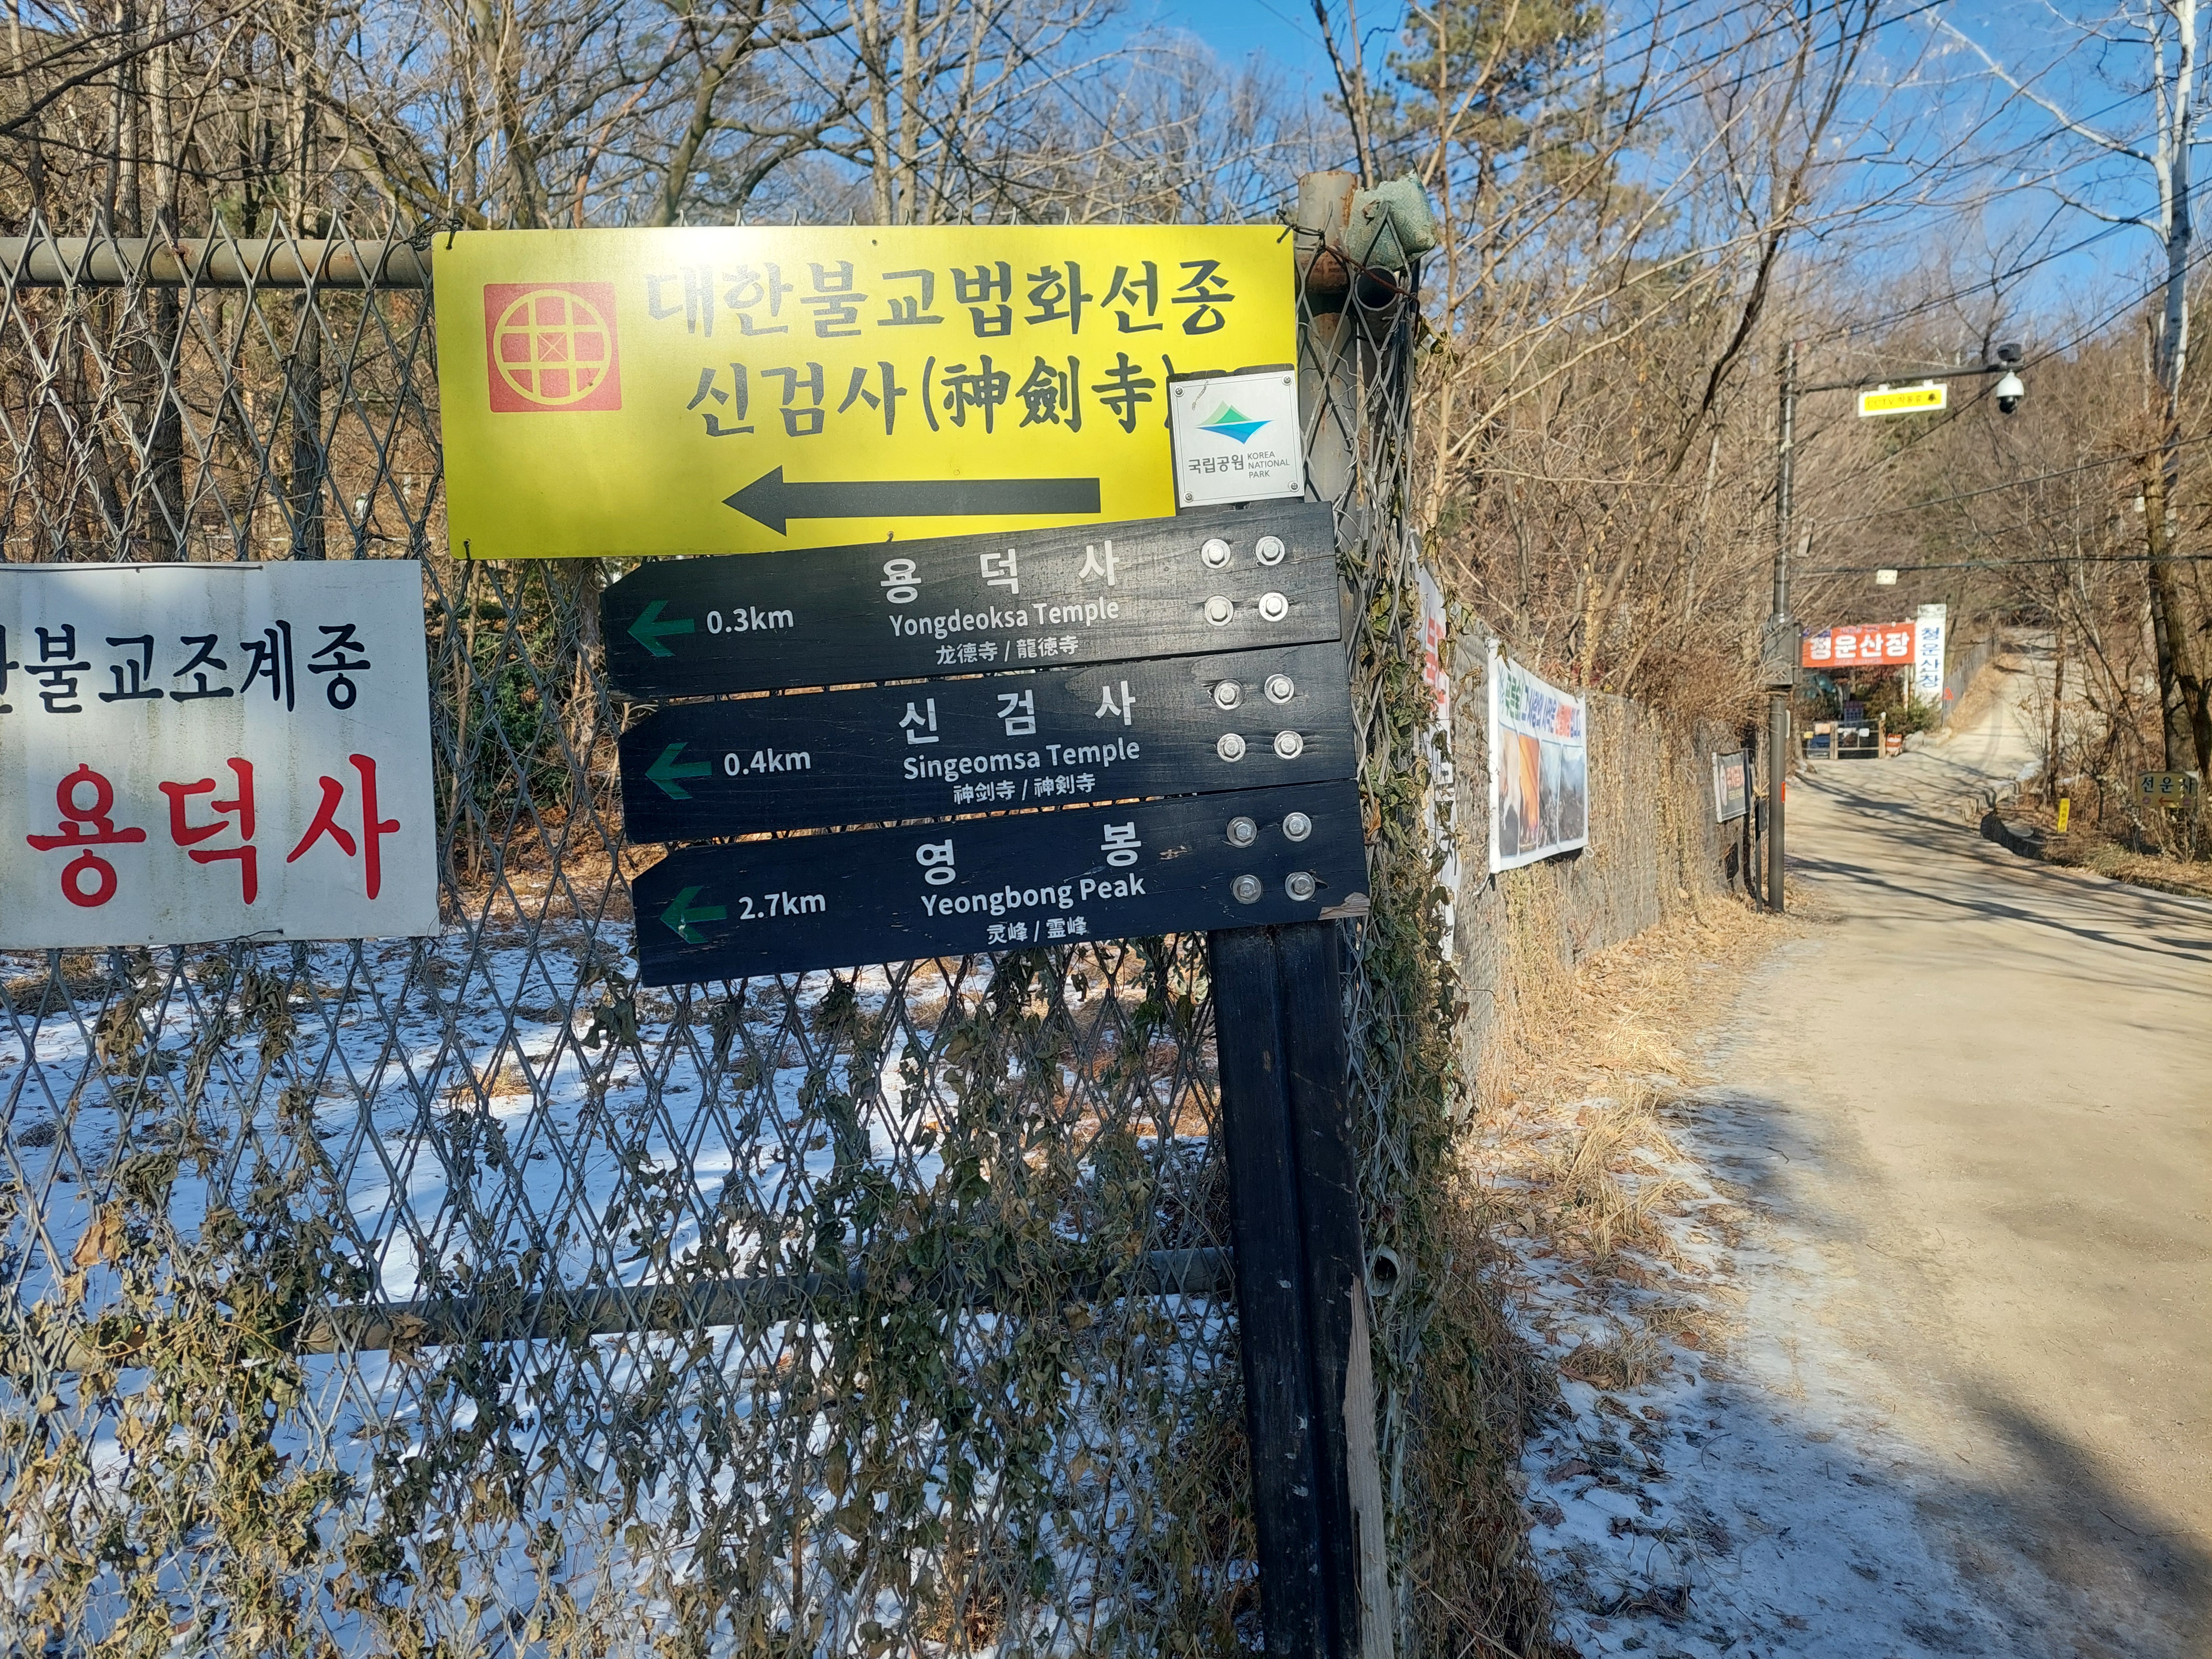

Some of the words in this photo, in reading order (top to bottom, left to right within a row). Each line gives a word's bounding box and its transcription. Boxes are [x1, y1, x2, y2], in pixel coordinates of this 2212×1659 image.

[645, 259, 1235, 338] 대한불교법화선종
[1188, 454, 1244, 474] 국립공원
[1248, 451, 1275, 460] KOREA
[1248, 459, 1290, 469] NATIONAL
[1249, 470, 1270, 478] PARK
[707, 606, 794, 634] 0.3km
[889, 604, 1029, 641] Yongdeoksa
[1034, 597, 1120, 629] Temple
[936, 641, 998, 665] 龙德寺
[1920, 627, 1940, 688] 청운산장
[724, 748, 812, 776] 0.4km
[903, 750, 1041, 782] Singeomsa
[1045, 738, 1140, 766] Temple
[953, 779, 1016, 805] 神剑寺
[1034, 773, 1096, 797] 神剣寺
[1727, 764, 1745, 789] 주차금지
[27, 753, 401, 907] 용덕사
[739, 890, 827, 920] 2.7km
[921, 885, 1074, 918] Yeongbong
[1079, 873, 1147, 902] Peak
[986, 922, 1028, 945] 灵峰
[1046, 916, 1087, 939] 霊峰
